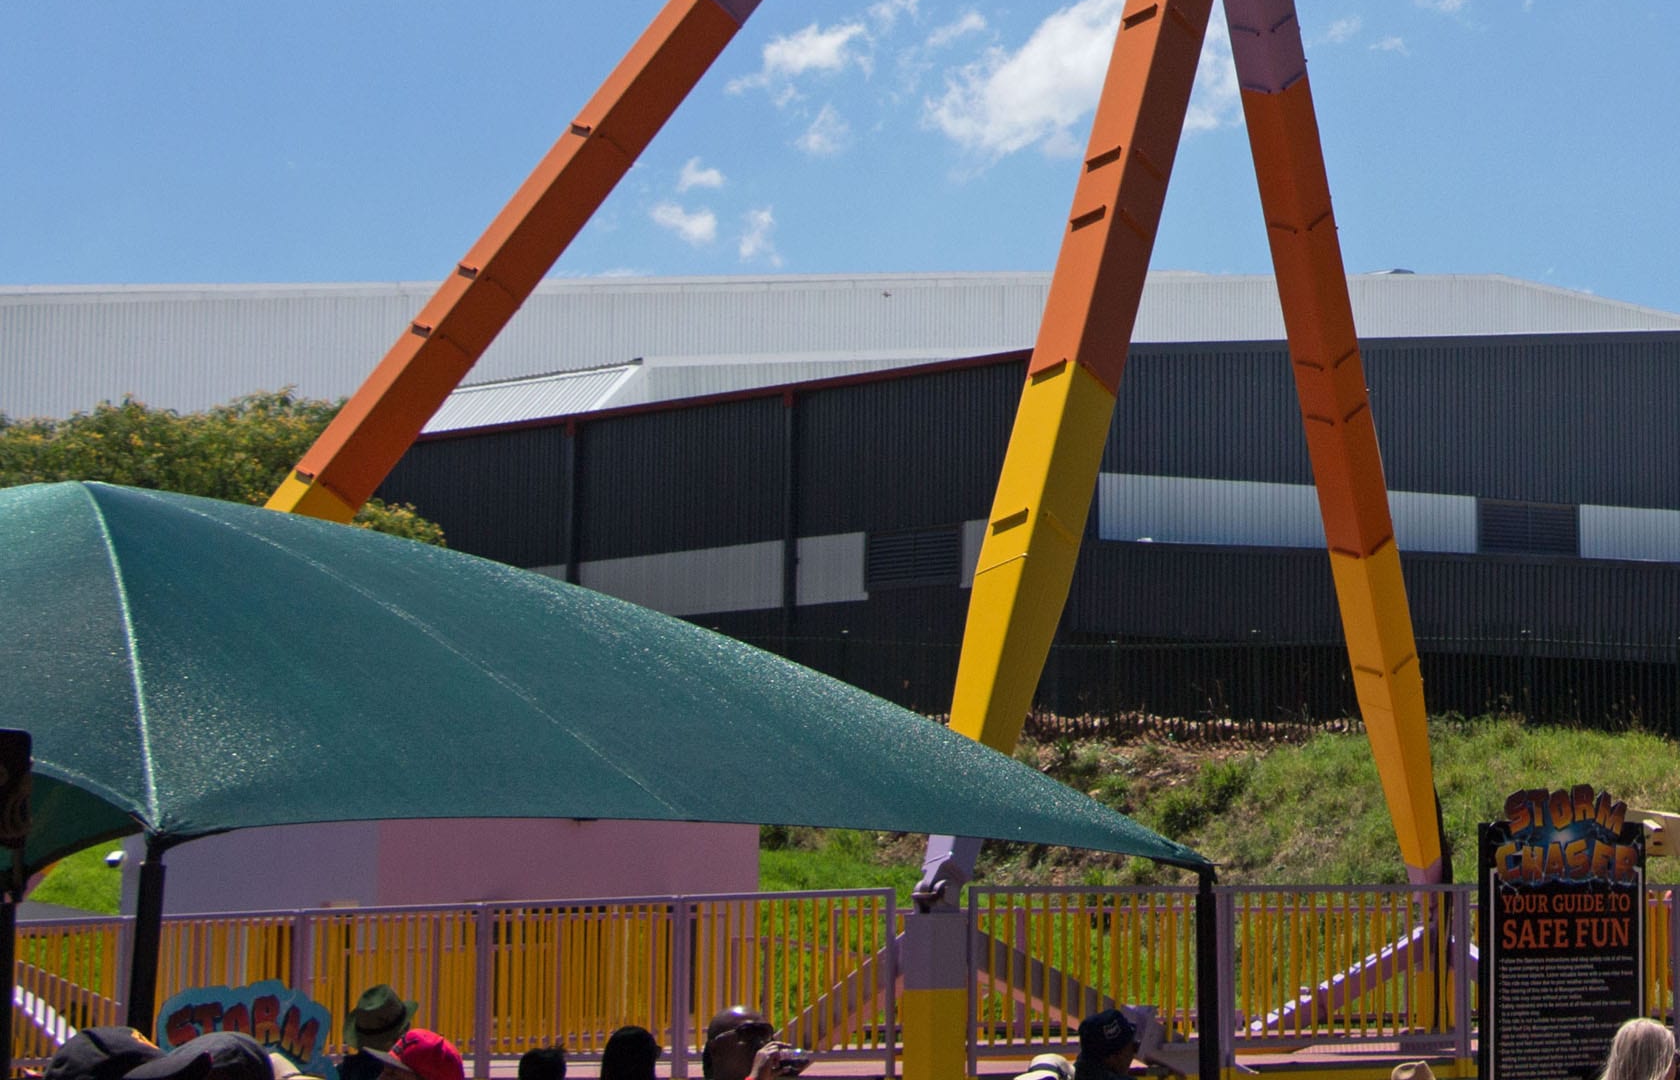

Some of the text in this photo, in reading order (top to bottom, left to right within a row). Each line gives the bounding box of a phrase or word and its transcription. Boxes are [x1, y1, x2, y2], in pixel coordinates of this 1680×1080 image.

[1504, 784, 1628, 836] STORM
[1495, 839, 1638, 881] CHASER
[1503, 893, 1631, 913] YOUR GUIDE TO
[1502, 917, 1630, 949] SAFE FUN
[166, 994, 320, 1063] STORM
